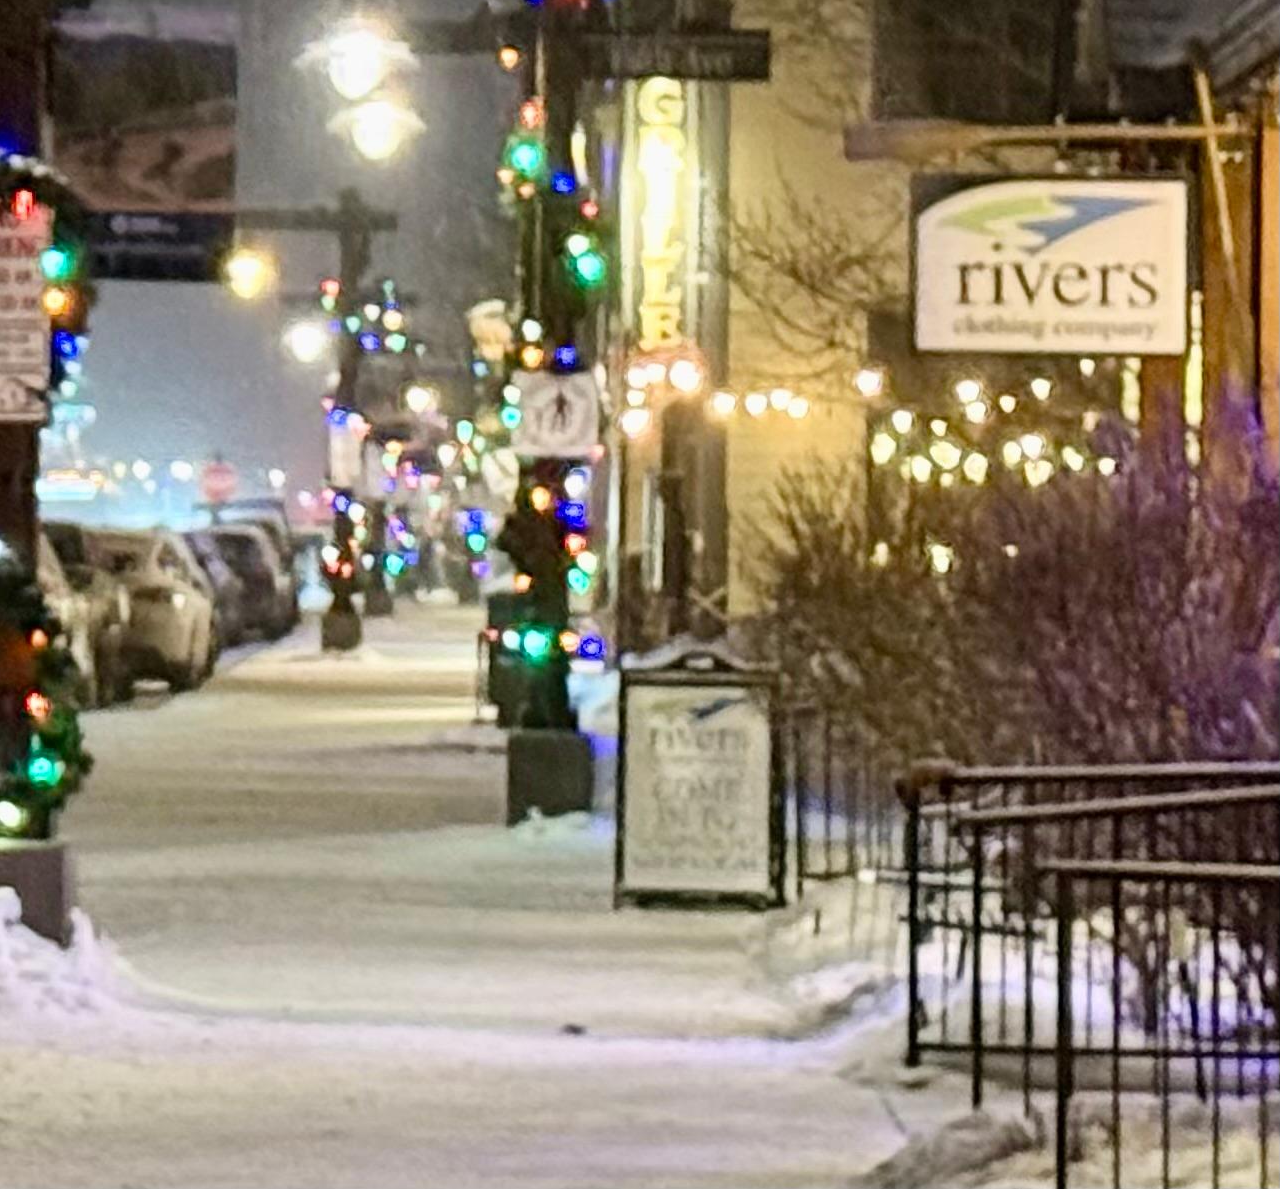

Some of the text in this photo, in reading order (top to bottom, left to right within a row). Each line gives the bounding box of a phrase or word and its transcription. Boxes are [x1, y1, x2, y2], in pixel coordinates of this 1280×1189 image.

[955, 242, 1160, 309] rivers
[952, 314, 1158, 341] clothing company
